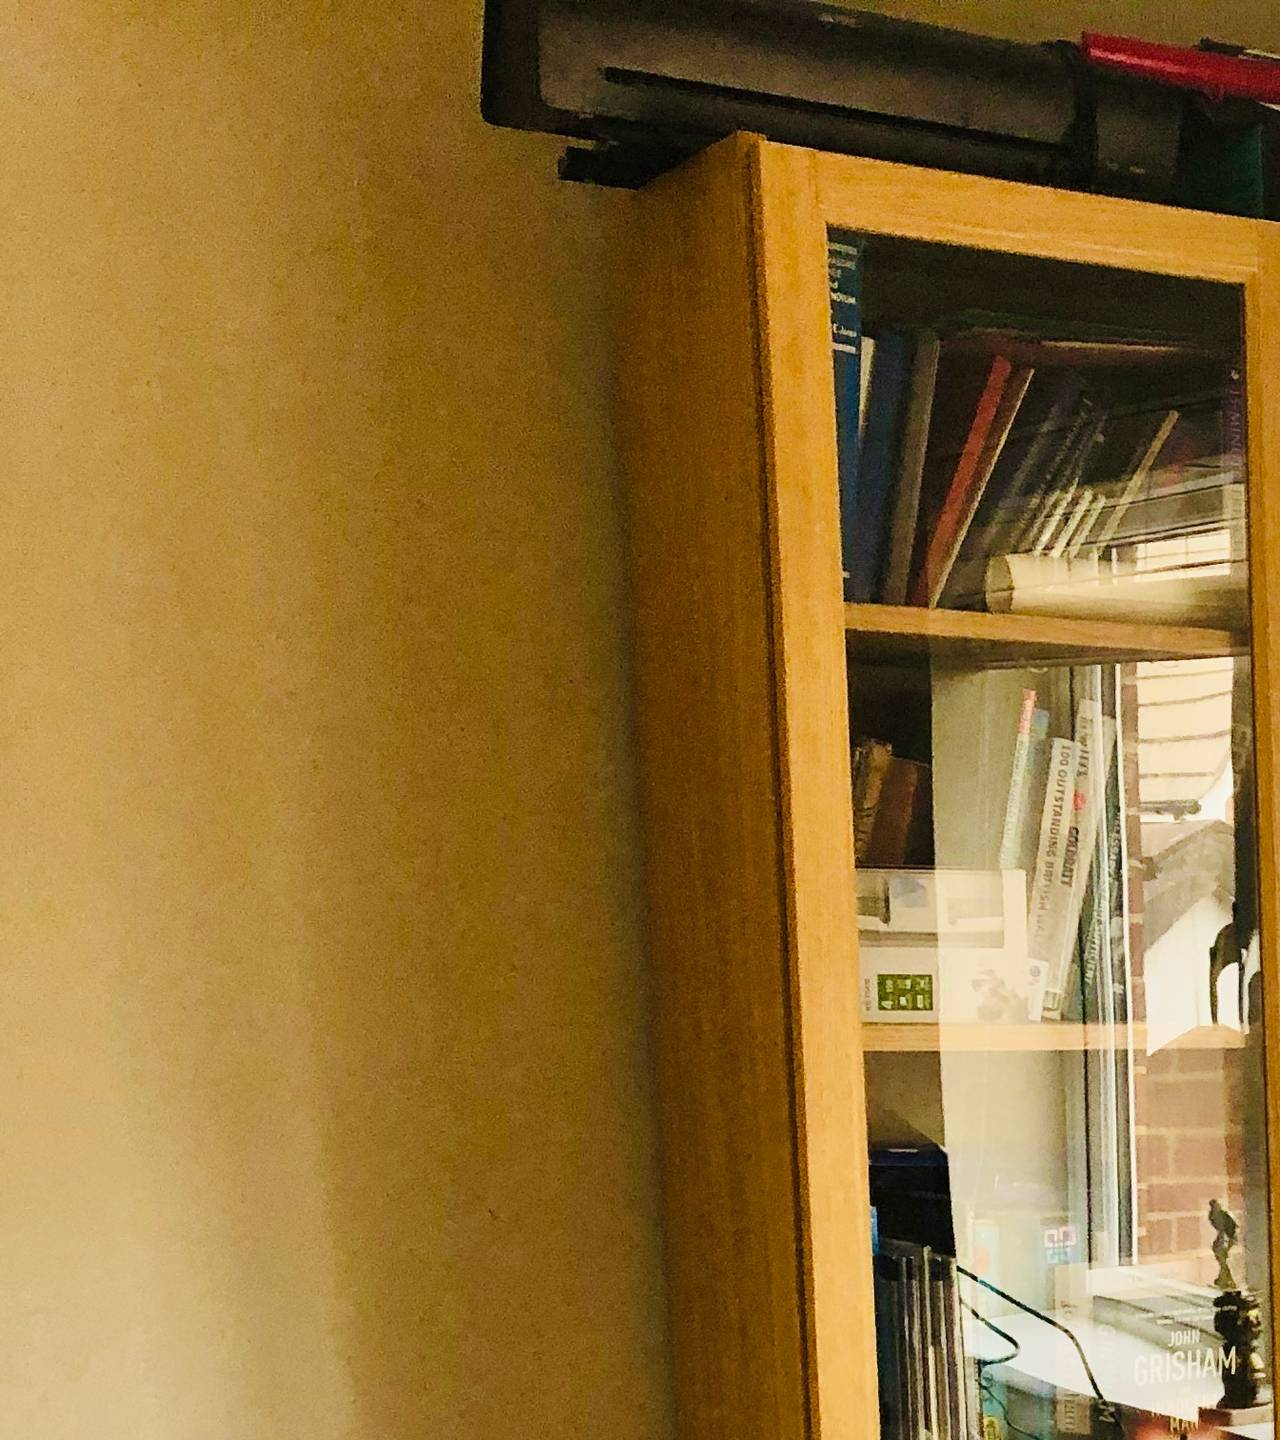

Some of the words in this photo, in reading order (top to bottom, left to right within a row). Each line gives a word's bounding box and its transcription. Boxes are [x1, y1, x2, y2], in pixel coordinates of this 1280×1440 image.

[1059, 744, 1071, 767] 100
[1046, 770, 1068, 858] OUTSTANDING
[1168, 1329, 1200, 1347] JOHN
[1134, 1345, 1236, 1387] GRISHAM
